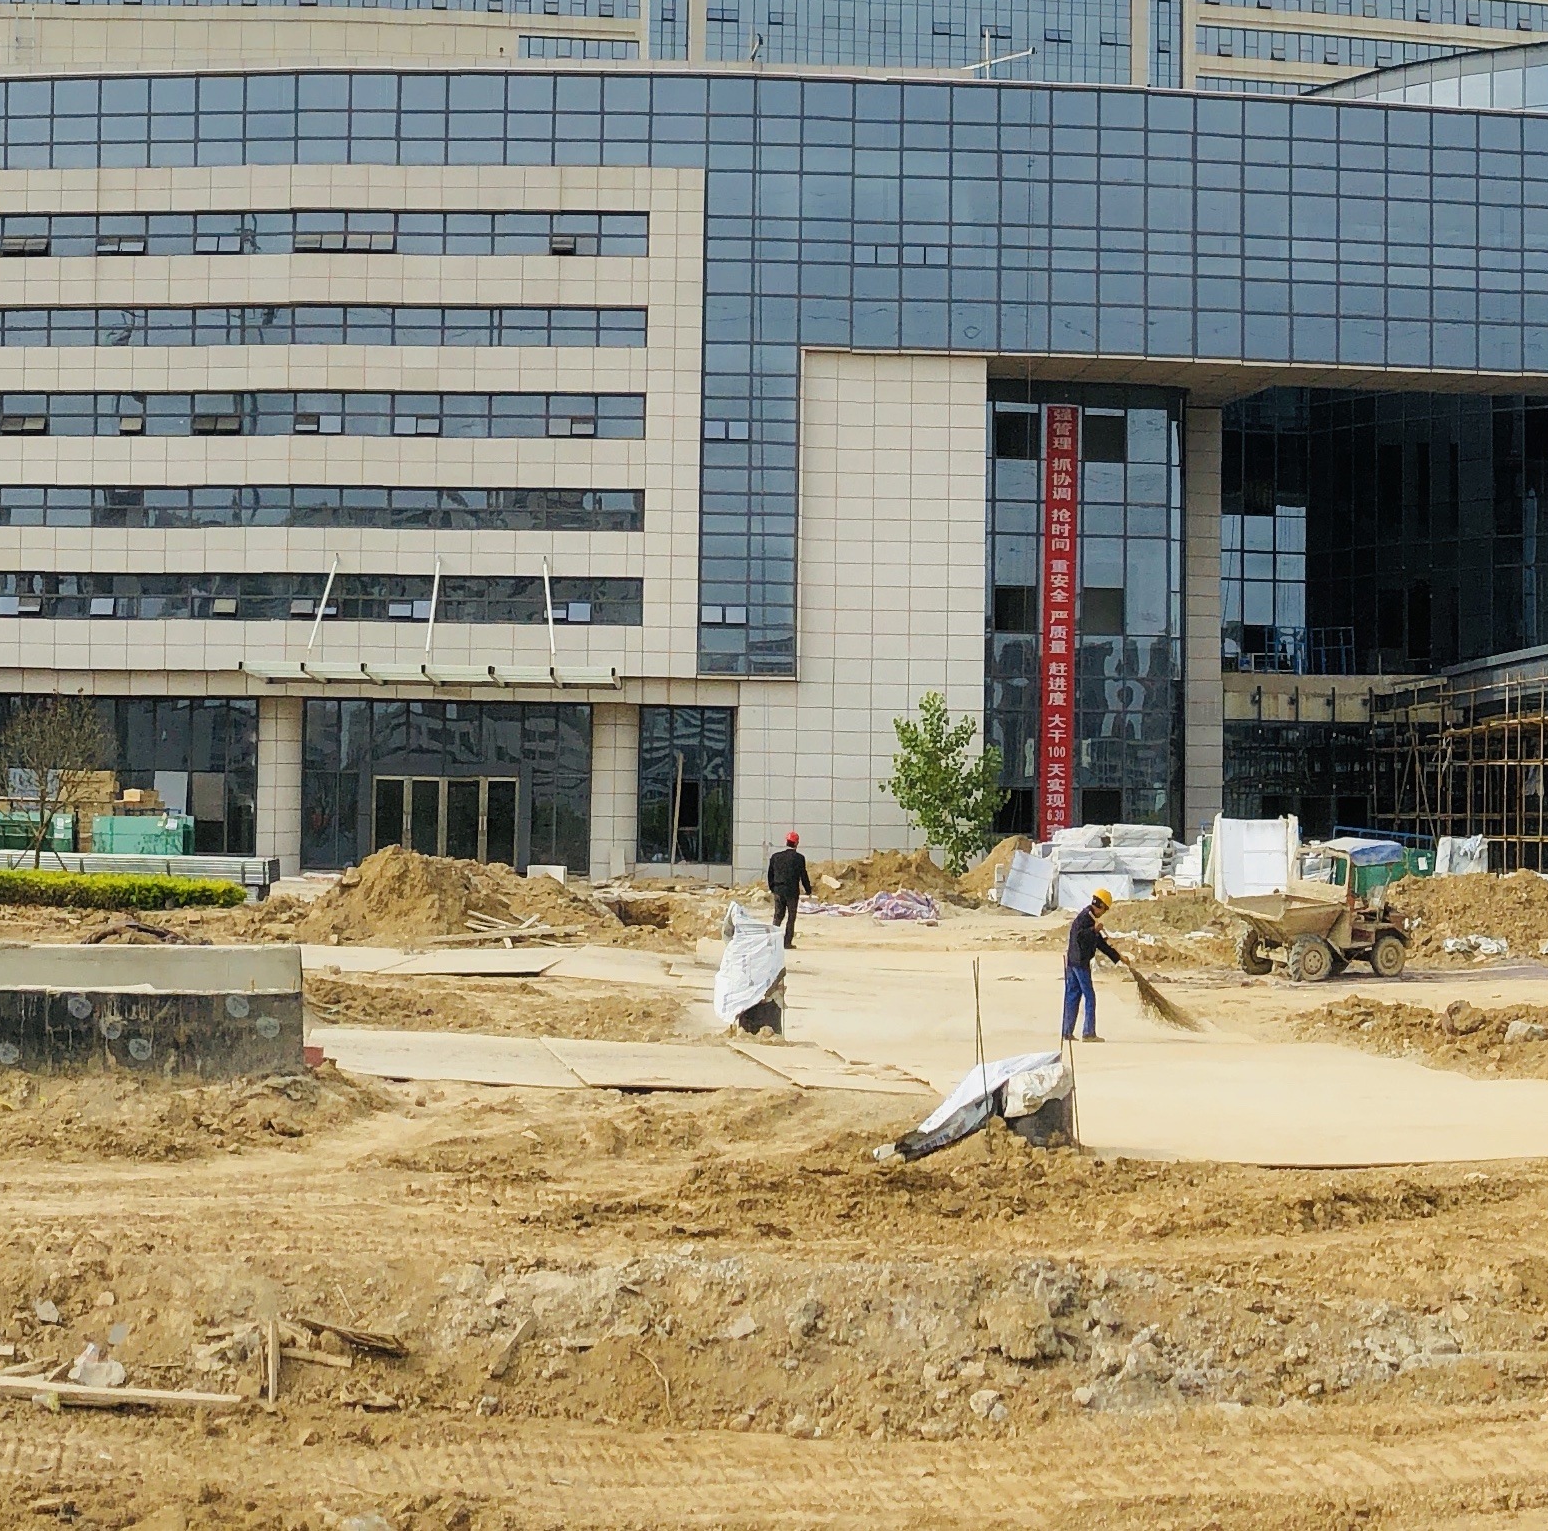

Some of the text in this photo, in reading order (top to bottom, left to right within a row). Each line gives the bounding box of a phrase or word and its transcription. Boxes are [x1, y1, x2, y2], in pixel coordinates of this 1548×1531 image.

[1052, 408, 1073, 450] 强管理
[1051, 457, 1072, 501] 抓协调
[1051, 508, 1071, 552] 抢时间
[1049, 559, 1070, 603] 重安全
[1049, 610, 1069, 654] 严质量
[1047, 662, 1068, 706] 赶进度
